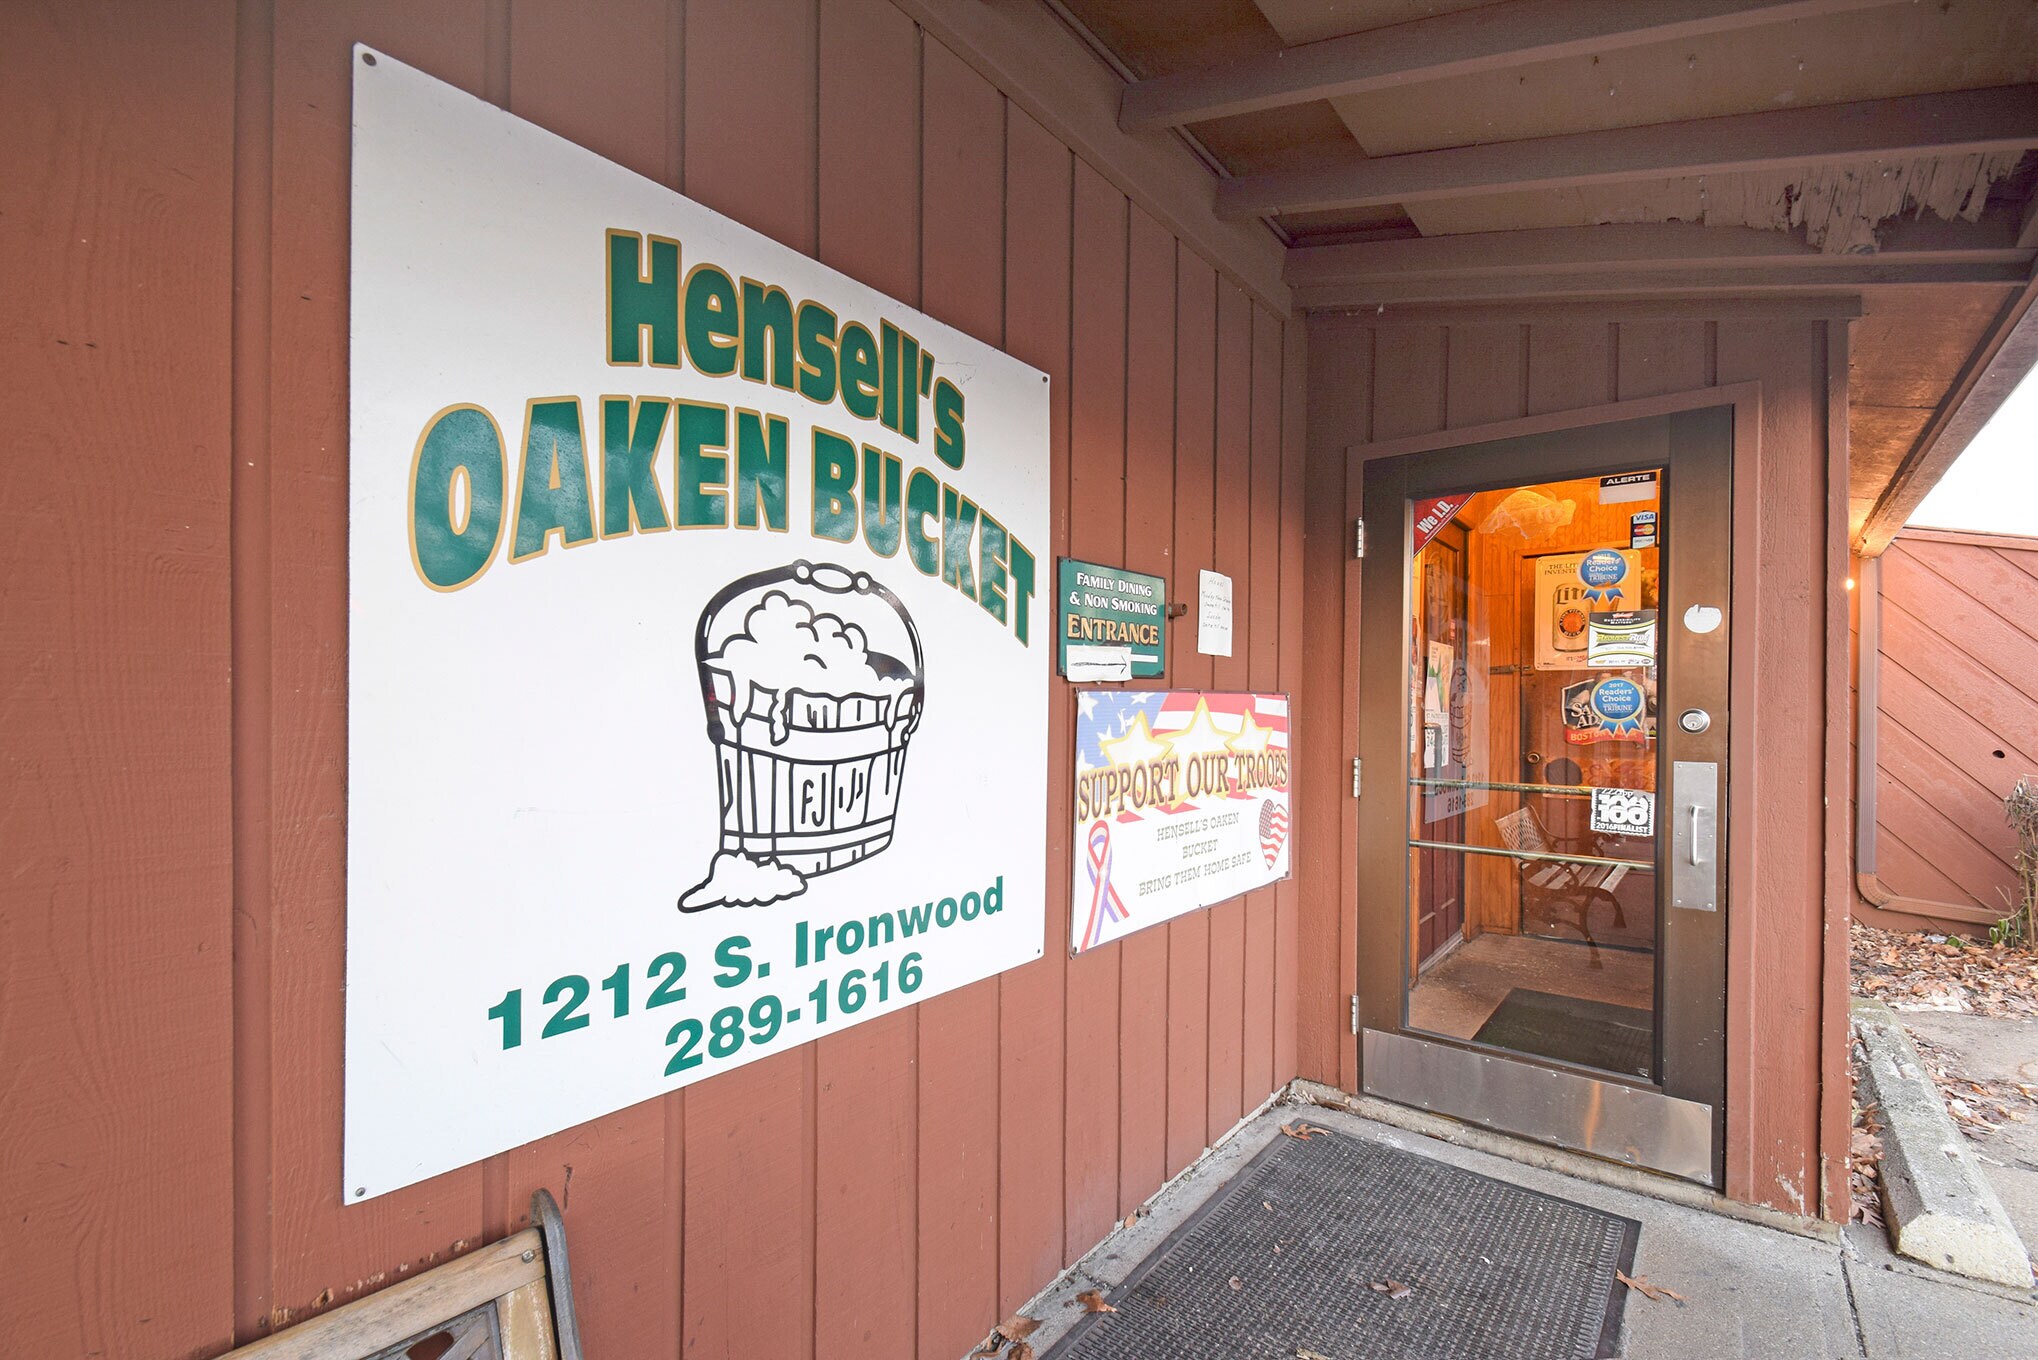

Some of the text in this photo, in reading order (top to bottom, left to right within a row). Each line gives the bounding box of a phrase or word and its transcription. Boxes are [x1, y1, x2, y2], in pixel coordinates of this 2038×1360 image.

[605, 227, 966, 470] Hensell's
[1606, 474, 1650, 485] ALERTE
[407, 394, 1036, 648] OAKEN BUCKET
[1416, 515, 1439, 534] We
[1432, 500, 1454, 518] I.D.
[1636, 513, 1655, 521] VISA
[1076, 572, 1152, 597] FAMILY DINING
[1589, 573, 1618, 581] TRIBUNE
[1069, 591, 1158, 615] & NON SMOKING
[1067, 613, 1159, 645] ENTRANCE
[1599, 687, 1634, 696] Readers'
[1603, 704, 1633, 712] TRIBUNE
[1078, 751, 1288, 822] SUPPORT OUR TROOPS
[1156, 812, 1240, 841] HENSELL'S OAKEN
[1182, 839, 1219, 859] BUCKET
[1138, 851, 1252, 896] BRING THEM HOME SAFE
[488, 875, 1004, 1051] 1212 S. Ironwood
[663, 952, 924, 1078] 289-1616
